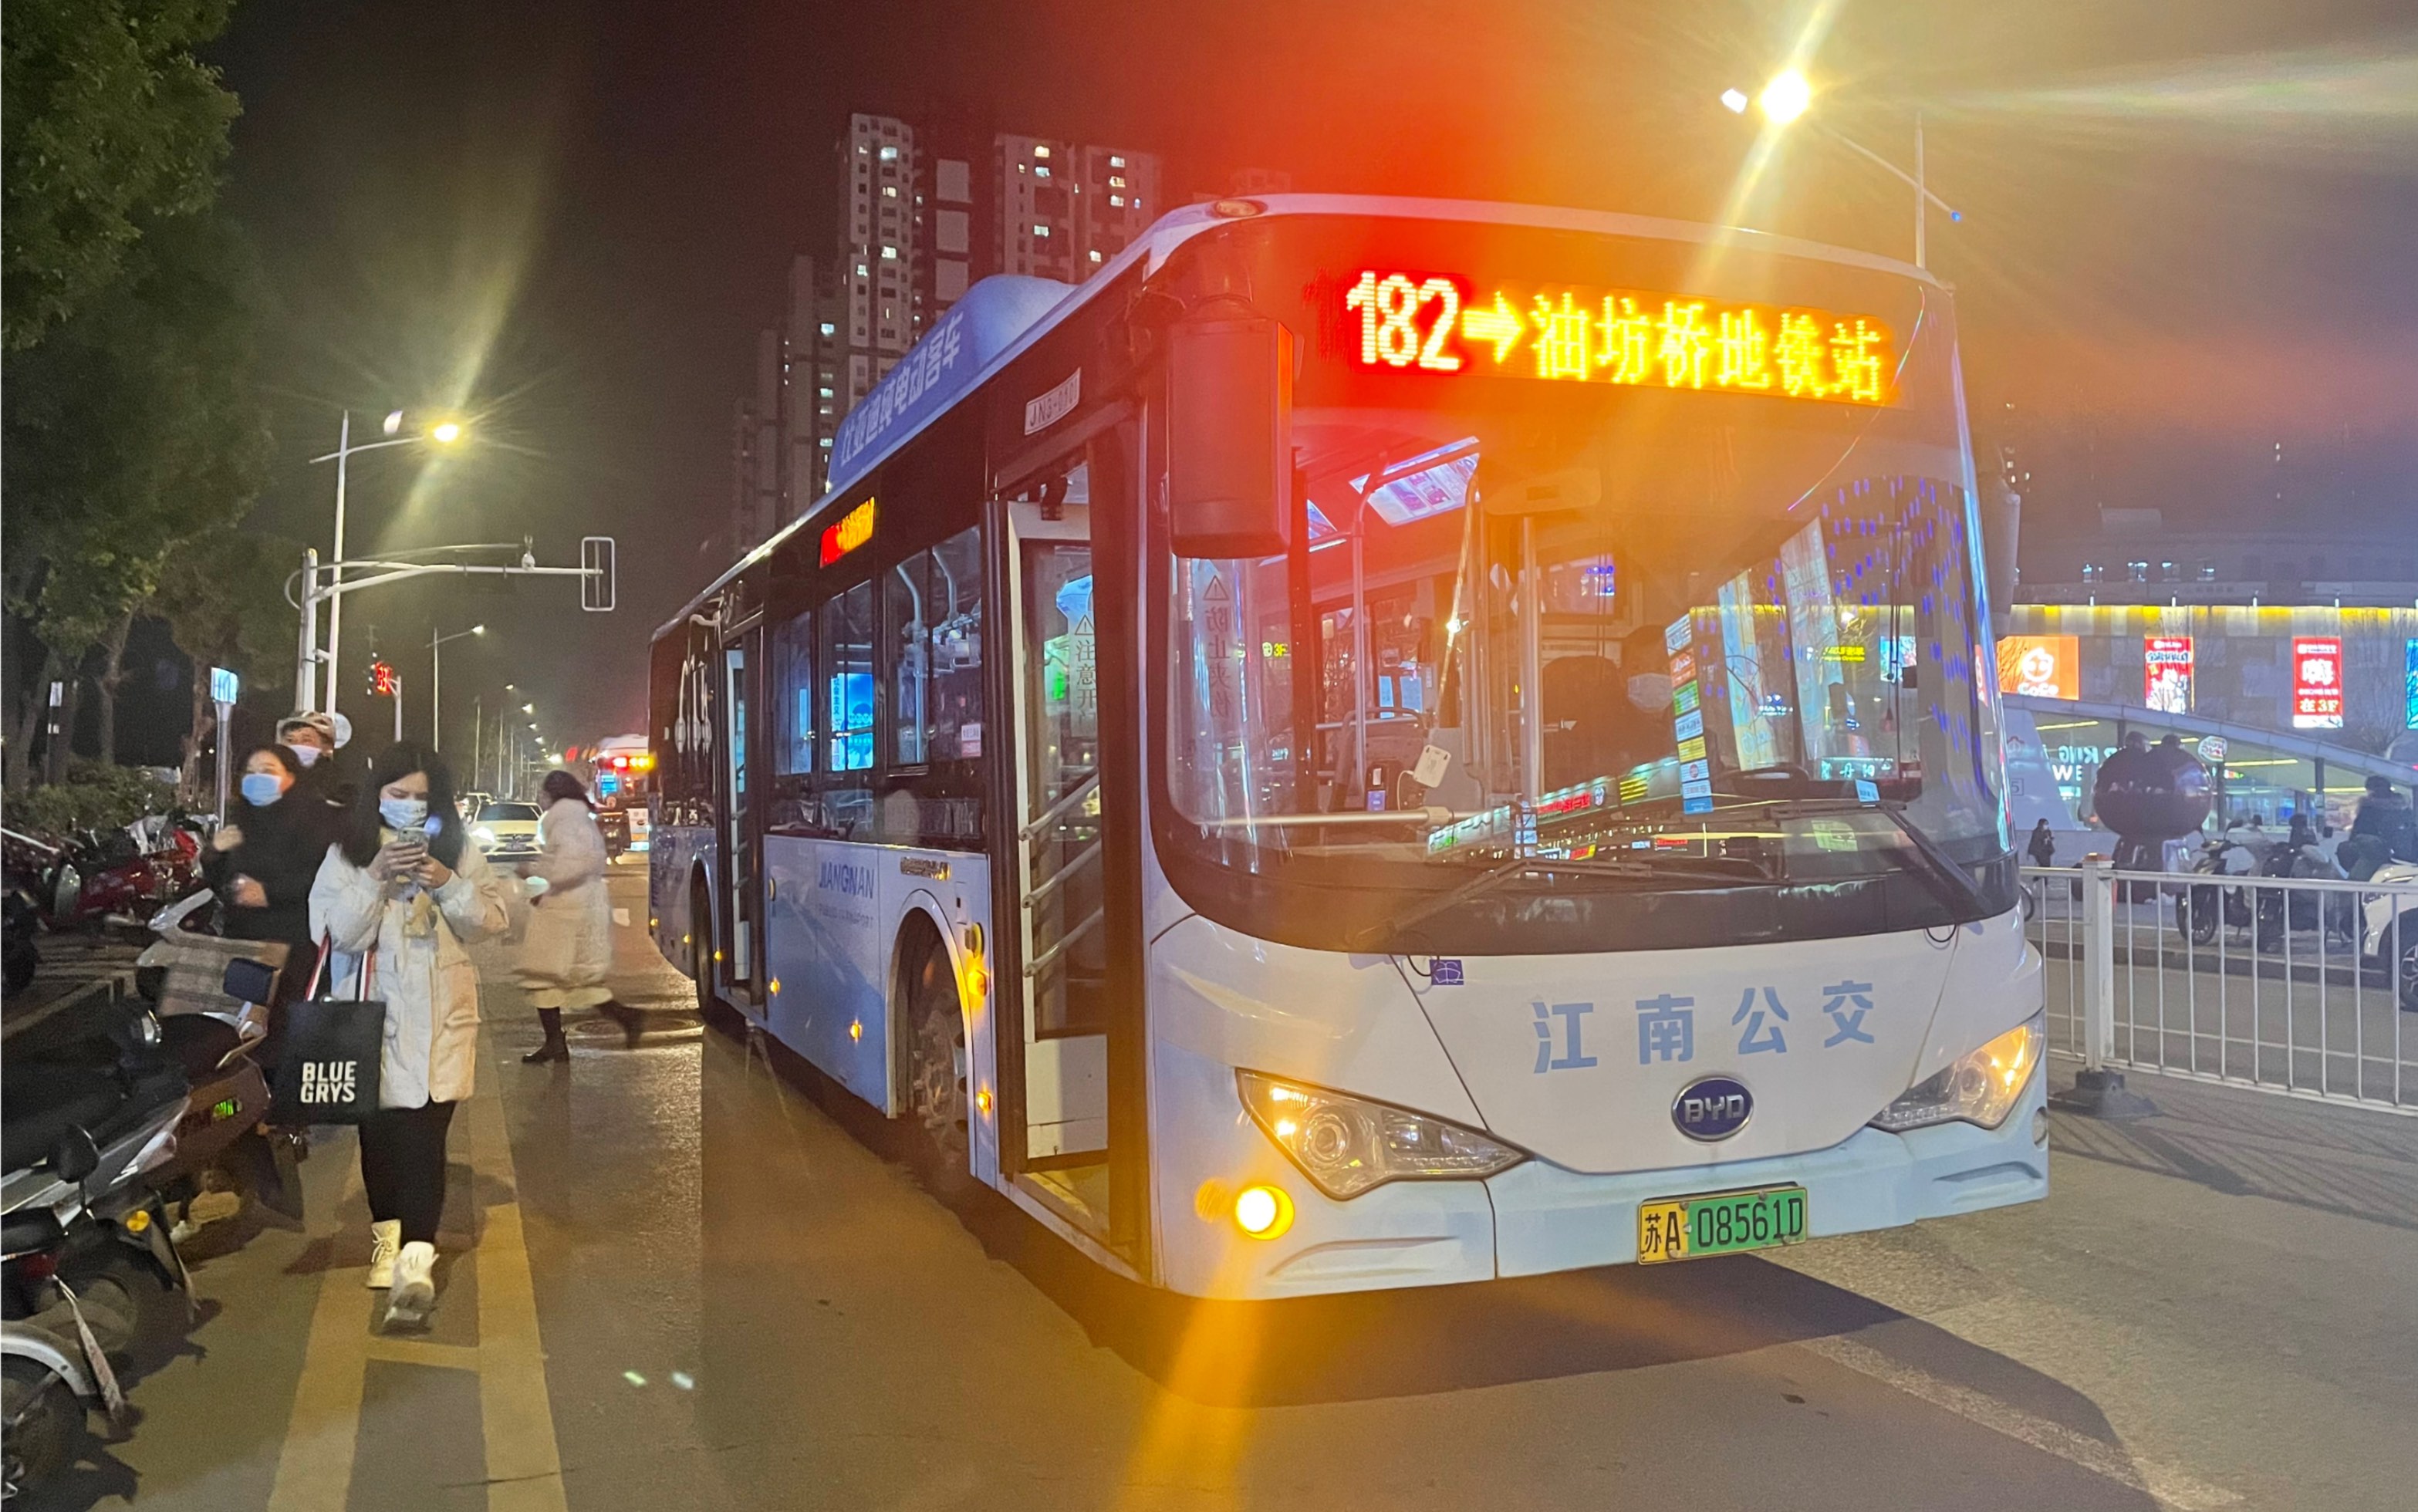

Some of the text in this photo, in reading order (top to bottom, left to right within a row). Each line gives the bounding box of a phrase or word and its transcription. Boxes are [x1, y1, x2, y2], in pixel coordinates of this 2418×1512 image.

[1346, 271, 1881, 401] 182 油坊桥地铁站
[819, 861, 874, 899] JIANGNAN
[1532, 980, 1875, 1074] 江南公交
[302, 1061, 356, 1082] BLUE
[300, 1082, 356, 1103] GRYS
[1684, 1094, 1744, 1123] BYD
